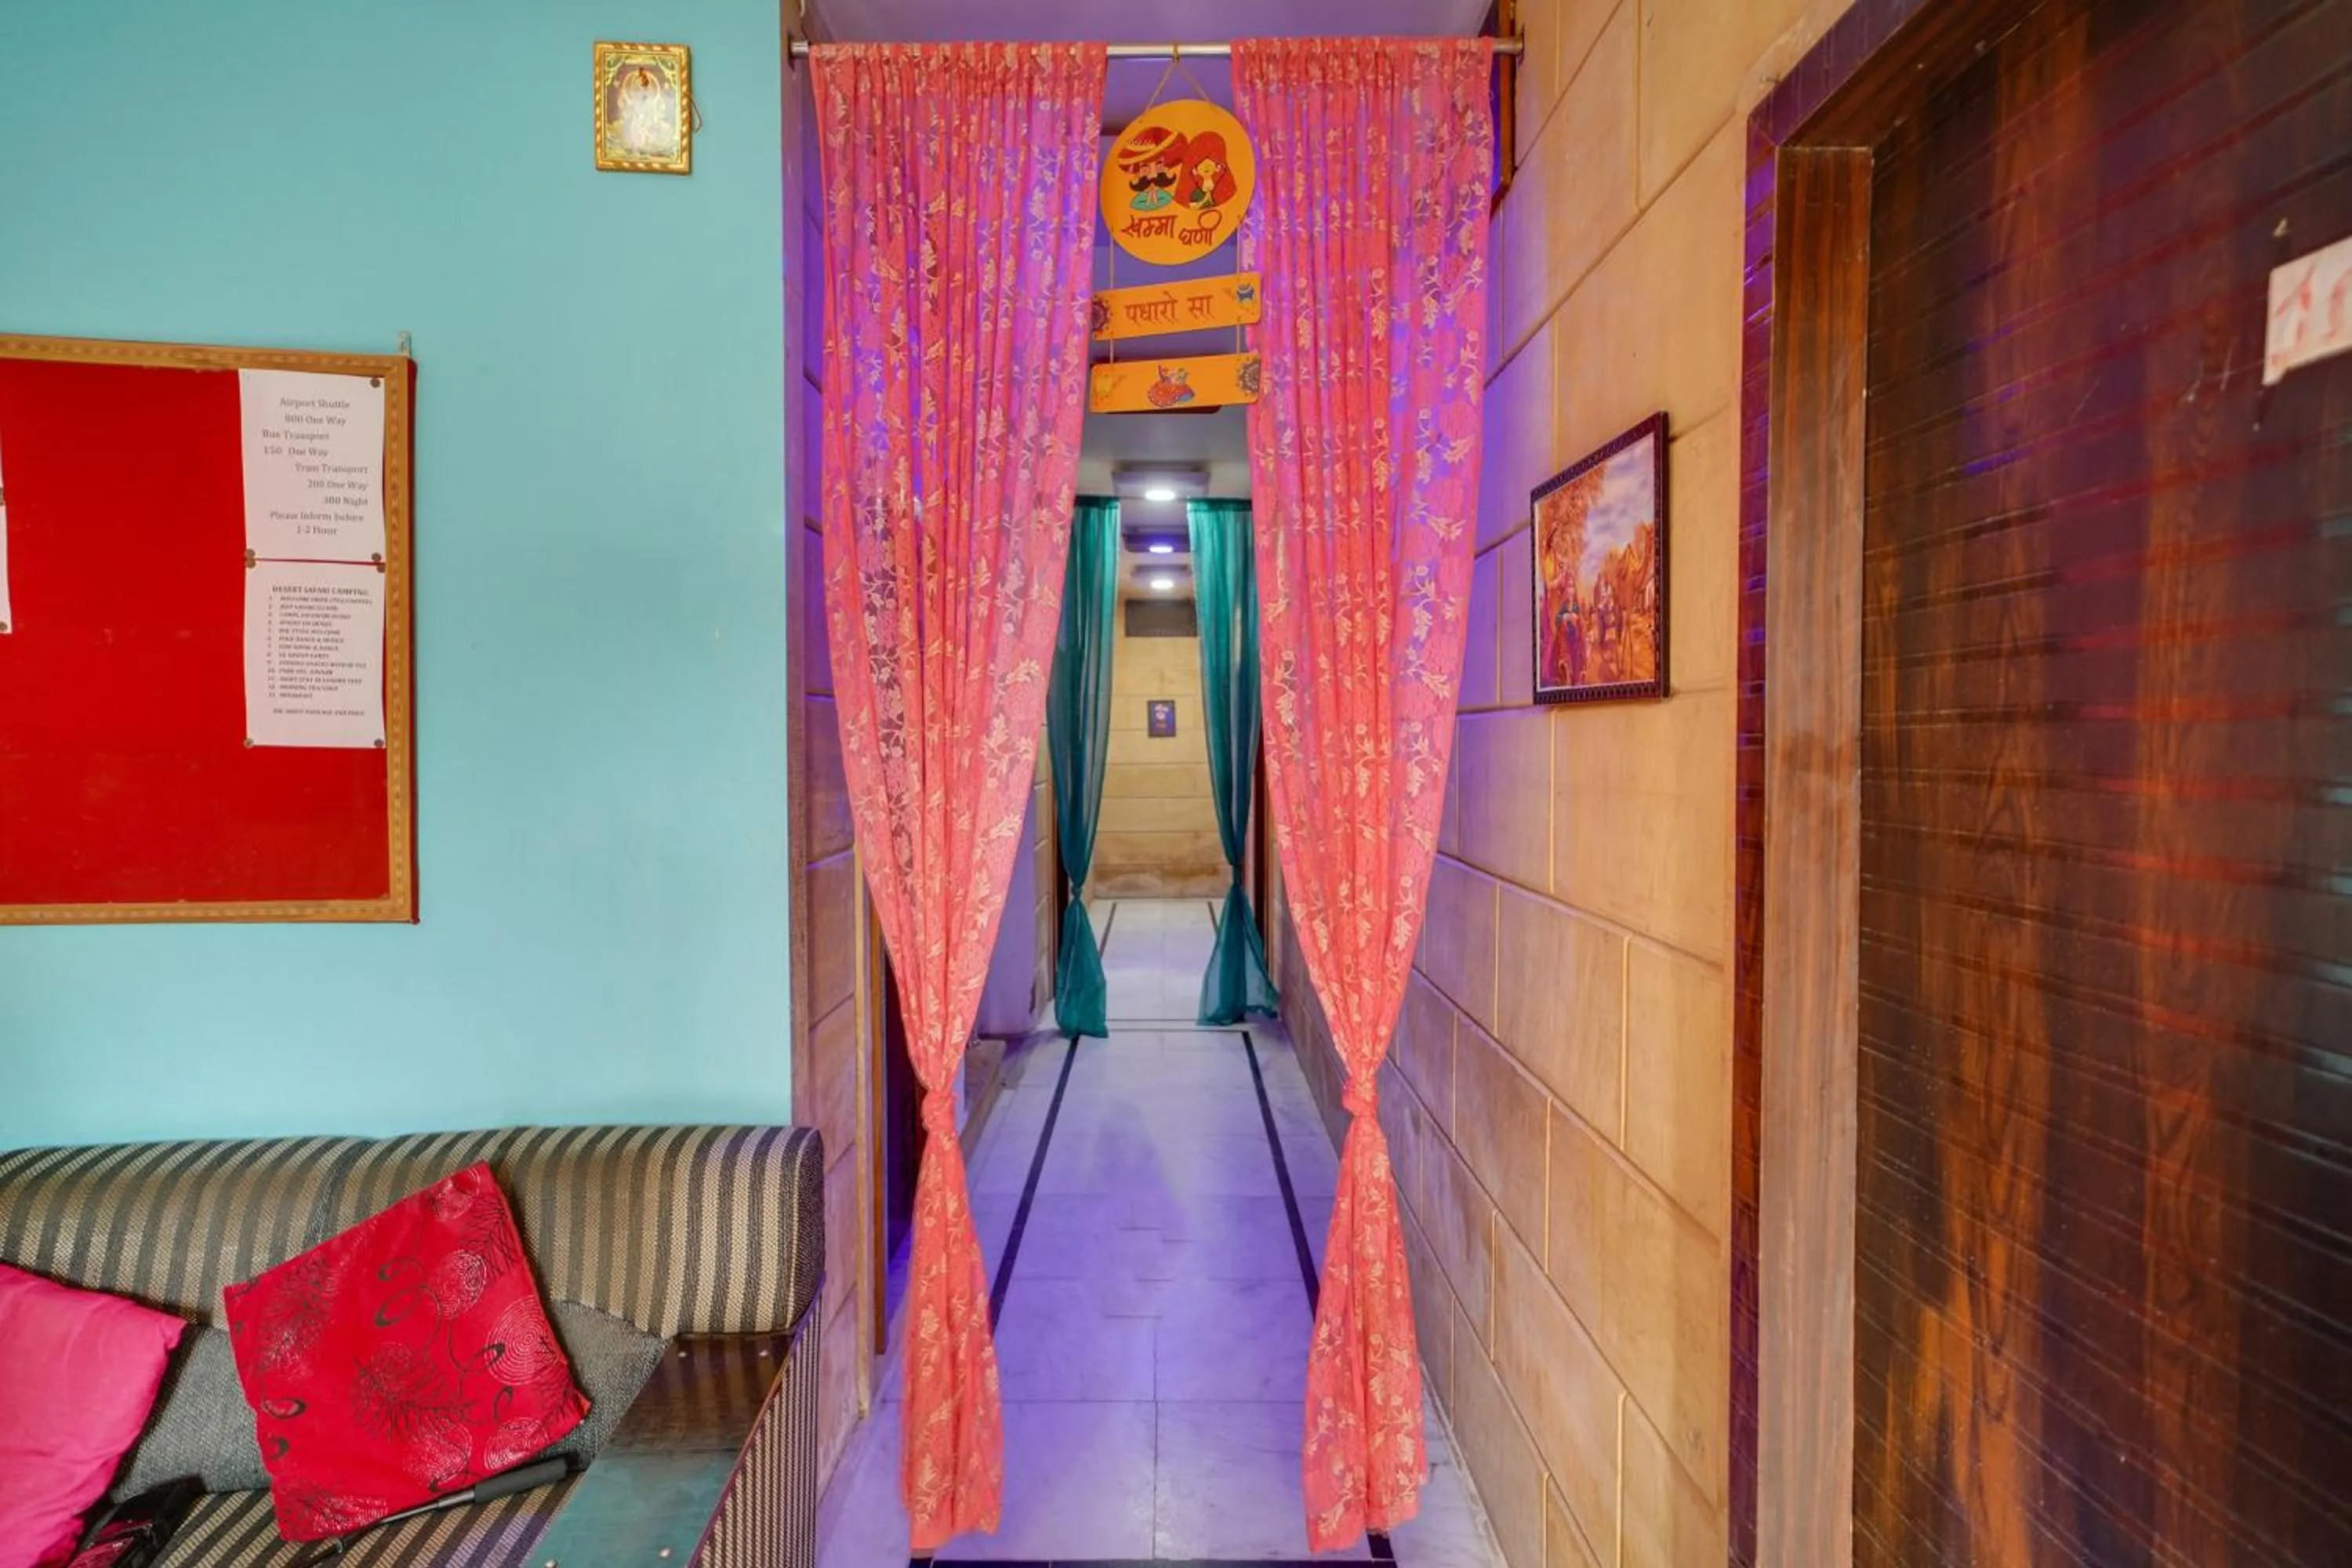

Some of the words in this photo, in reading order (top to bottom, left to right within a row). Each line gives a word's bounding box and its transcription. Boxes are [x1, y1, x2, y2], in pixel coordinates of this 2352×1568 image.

[1124, 290, 1178, 326] पधारो
[1187, 294, 1214, 321] सा
[280, 397, 315, 409] Airport
[318, 398, 350, 408] Shuttle
[326, 416, 347, 427] Way
[309, 448, 328, 458] Way
[347, 481, 368, 492] Way
